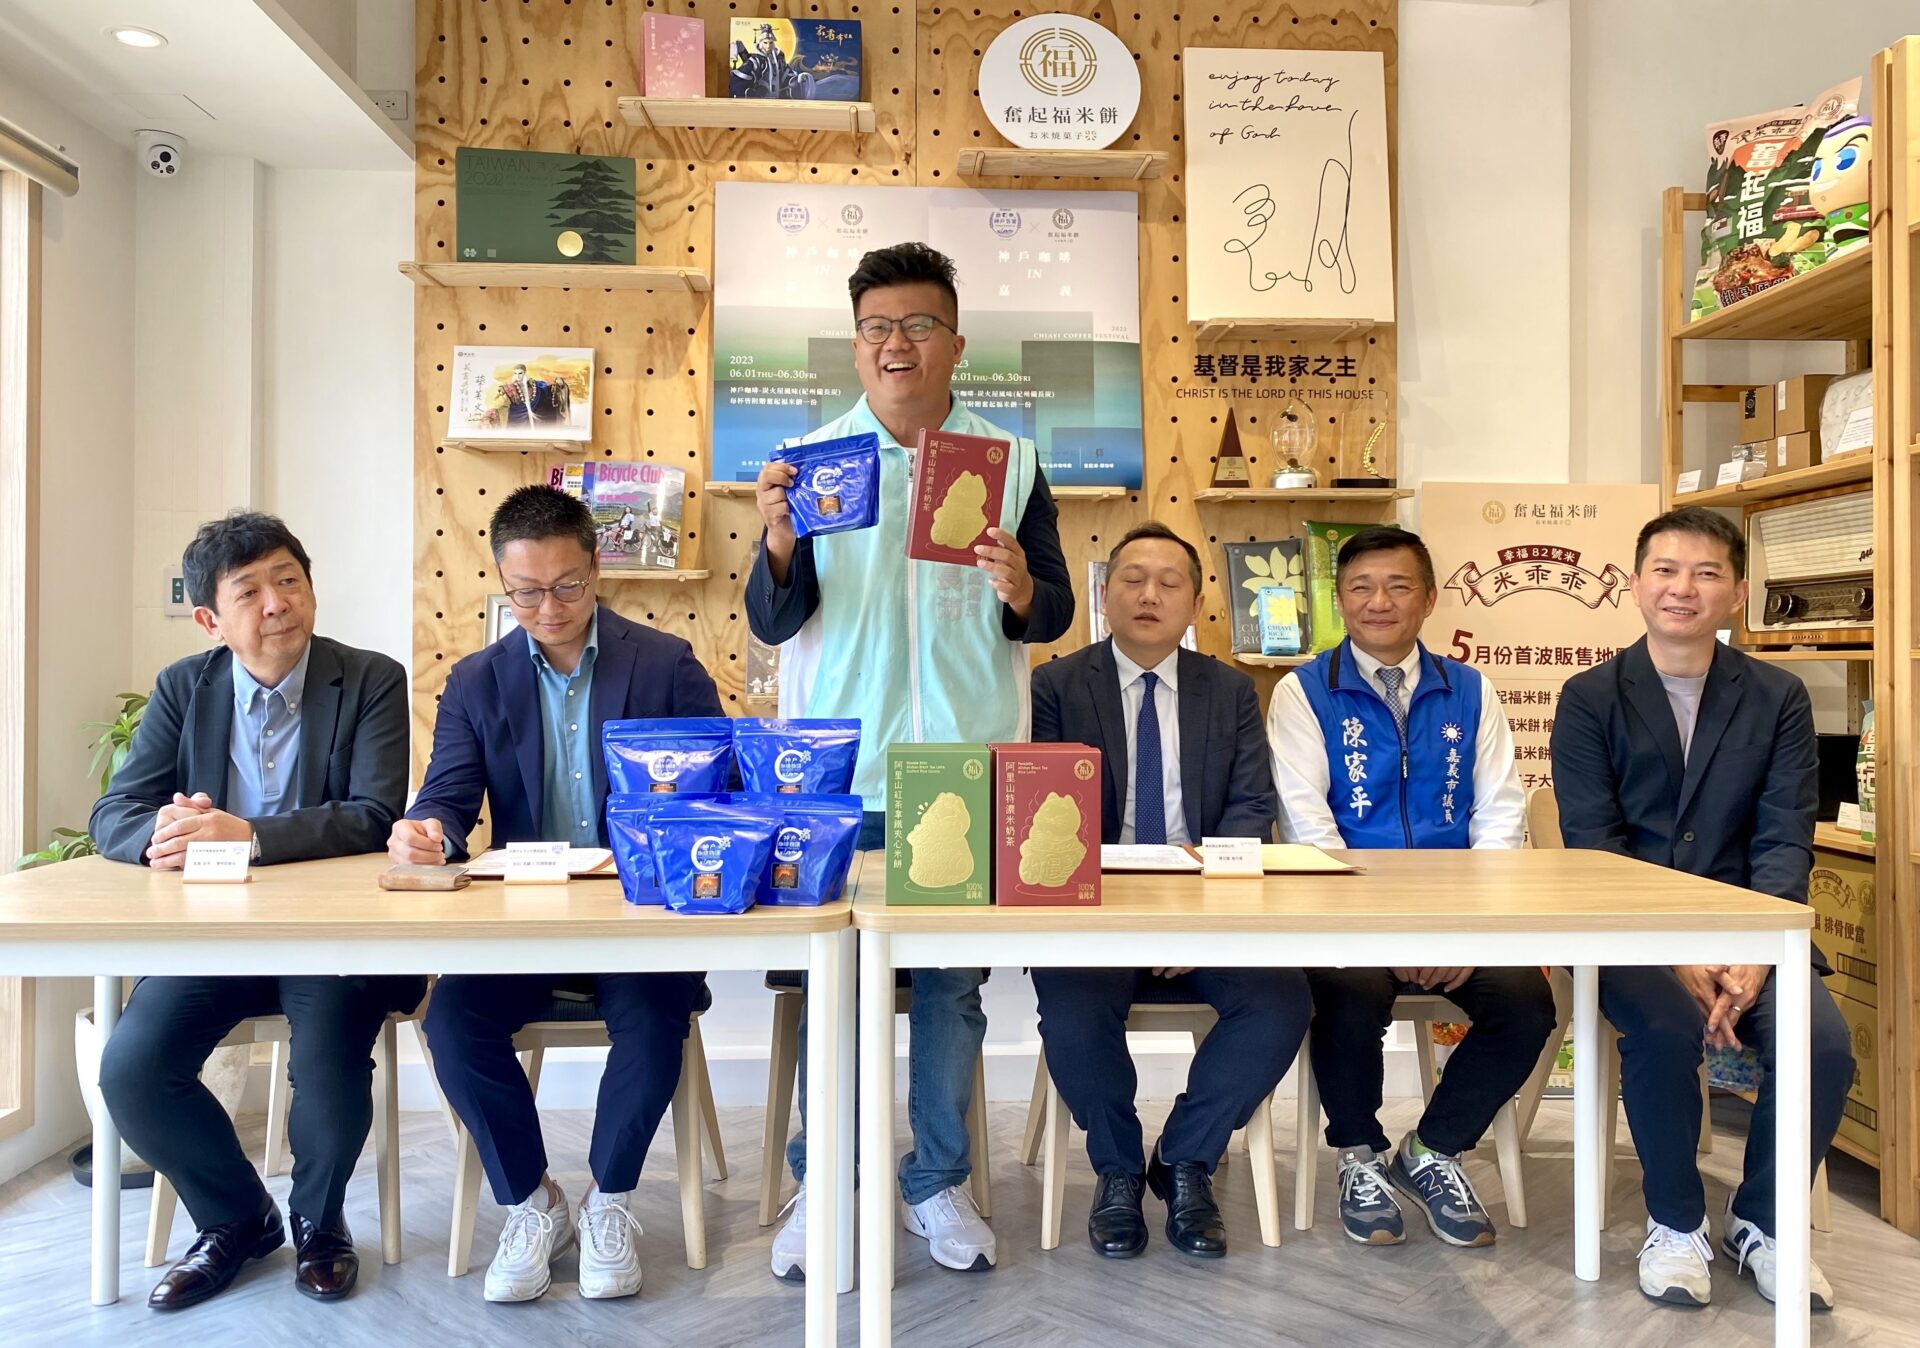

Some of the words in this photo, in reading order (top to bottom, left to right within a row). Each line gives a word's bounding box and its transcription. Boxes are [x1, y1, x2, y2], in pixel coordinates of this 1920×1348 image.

[1038, 44, 1077, 78] 福
[1209, 72, 1270, 93] enjoy
[1274, 69, 1340, 92] today
[1209, 100, 1238, 110] in
[1240, 96, 1284, 111] the
[1004, 106, 1118, 124] 奮起福米餅
[1210, 128, 1234, 144] of
[1241, 125, 1280, 139] God
[464, 155, 531, 172] TAIWAN
[1737, 141, 1787, 239] 奮起福
[1027, 269, 1043, 279] IN
[729, 355, 753, 365] 2023
[954, 359, 969, 368] 23
[1194, 354, 1357, 377] 基督是我家之主
[951, 372, 1031, 382] 6.01THU-06.30FRI
[1176, 388, 1215, 399] CHRIST
[1219, 389, 1228, 399] IS
[1232, 389, 1253, 399] THE
[1256, 389, 1286, 399] LORD
[1289, 389, 1304, 399] OF
[1309, 389, 1332, 399] THIS
[1336, 389, 1375, 400] HOUSE
[600, 463, 638, 484] Bicycle
[1514, 503, 1598, 519] 奮起福米餅
[1494, 565, 1587, 593] 米乖乖
[1496, 690, 1551, 705] 起福米餅
[1508, 718, 1540, 733] 福米餅
[1514, 746, 1552, 760] 福米餅
[1342, 716, 1372, 818] 陳家平
[1442, 748, 1462, 824] 嘉義市議員
[1522, 774, 1552, 788] 子大
[1005, 761, 1016, 847] 阿里山特濃米奶茶
[1825, 916, 1865, 944] 排骨便當
[1415, 1170, 1443, 1202] N
